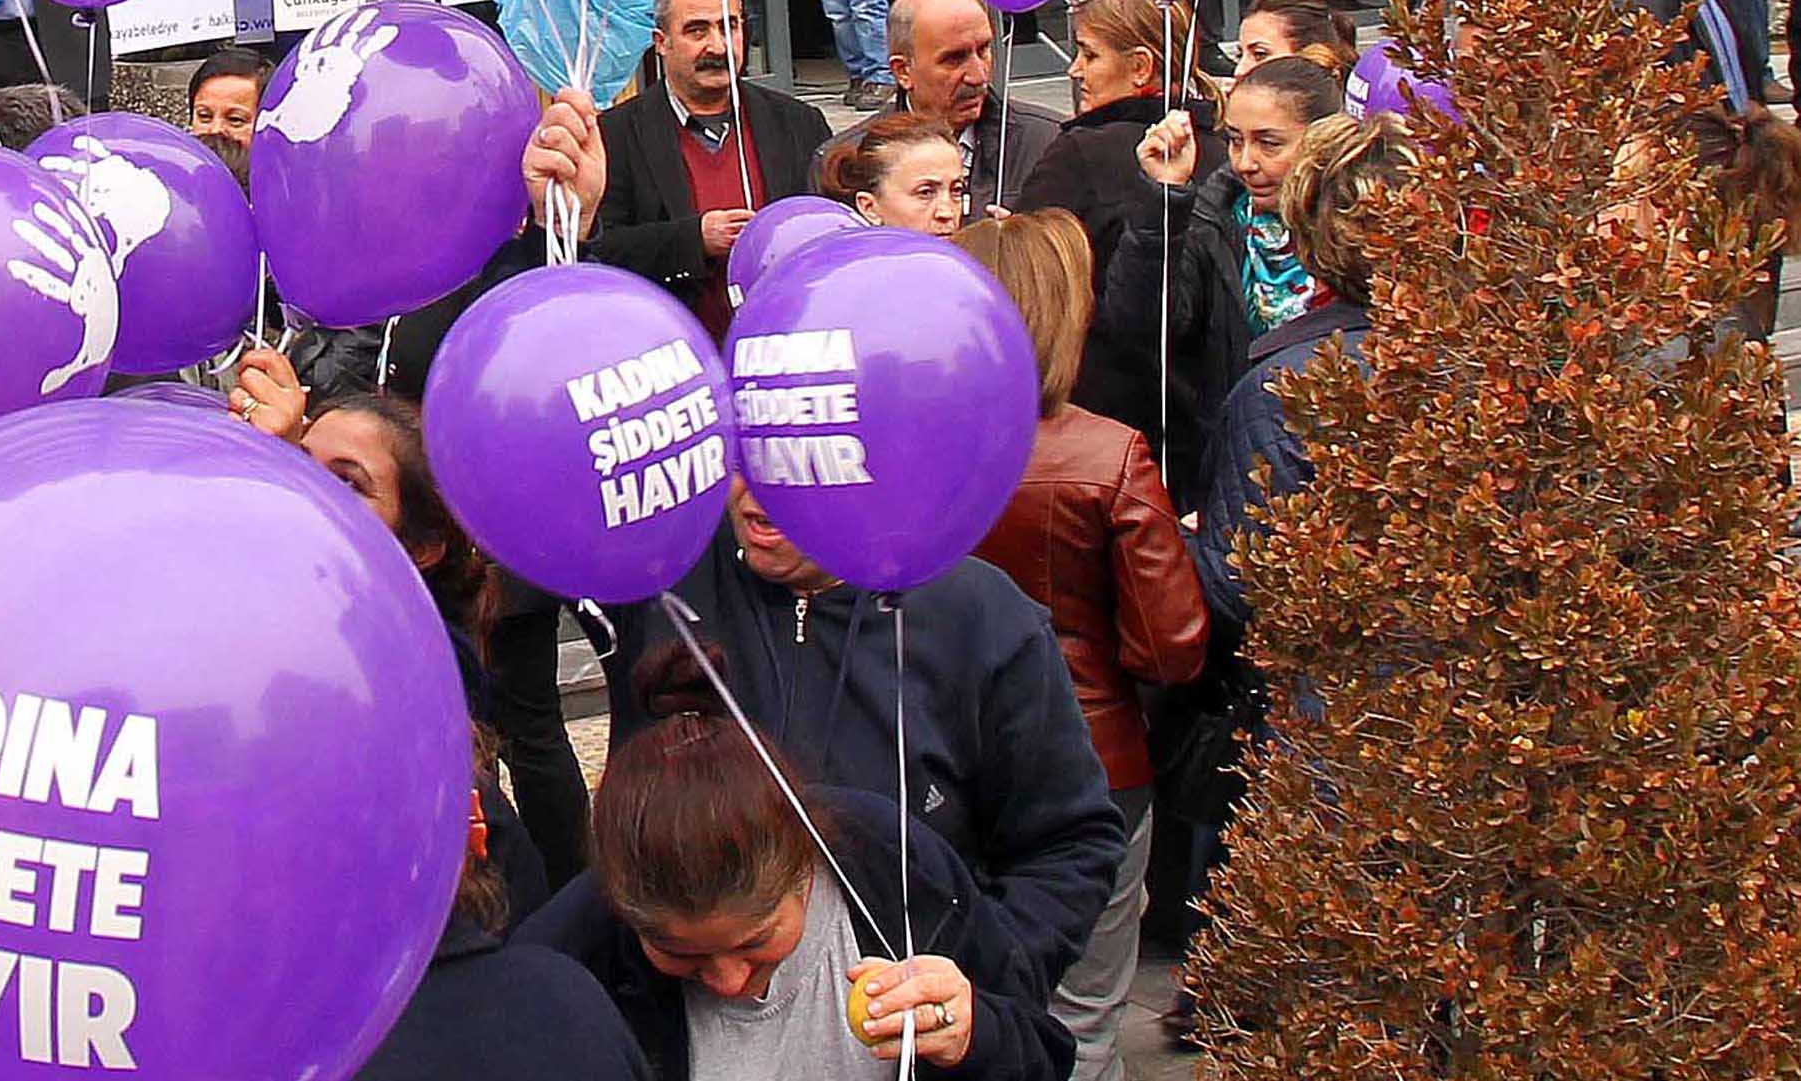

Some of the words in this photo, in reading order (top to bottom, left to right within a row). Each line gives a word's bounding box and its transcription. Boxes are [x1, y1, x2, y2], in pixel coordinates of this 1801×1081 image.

[566, 339, 704, 423] KADINA
[589, 386, 720, 476] ŞİDDETE
[600, 436, 727, 529] HAYIR
